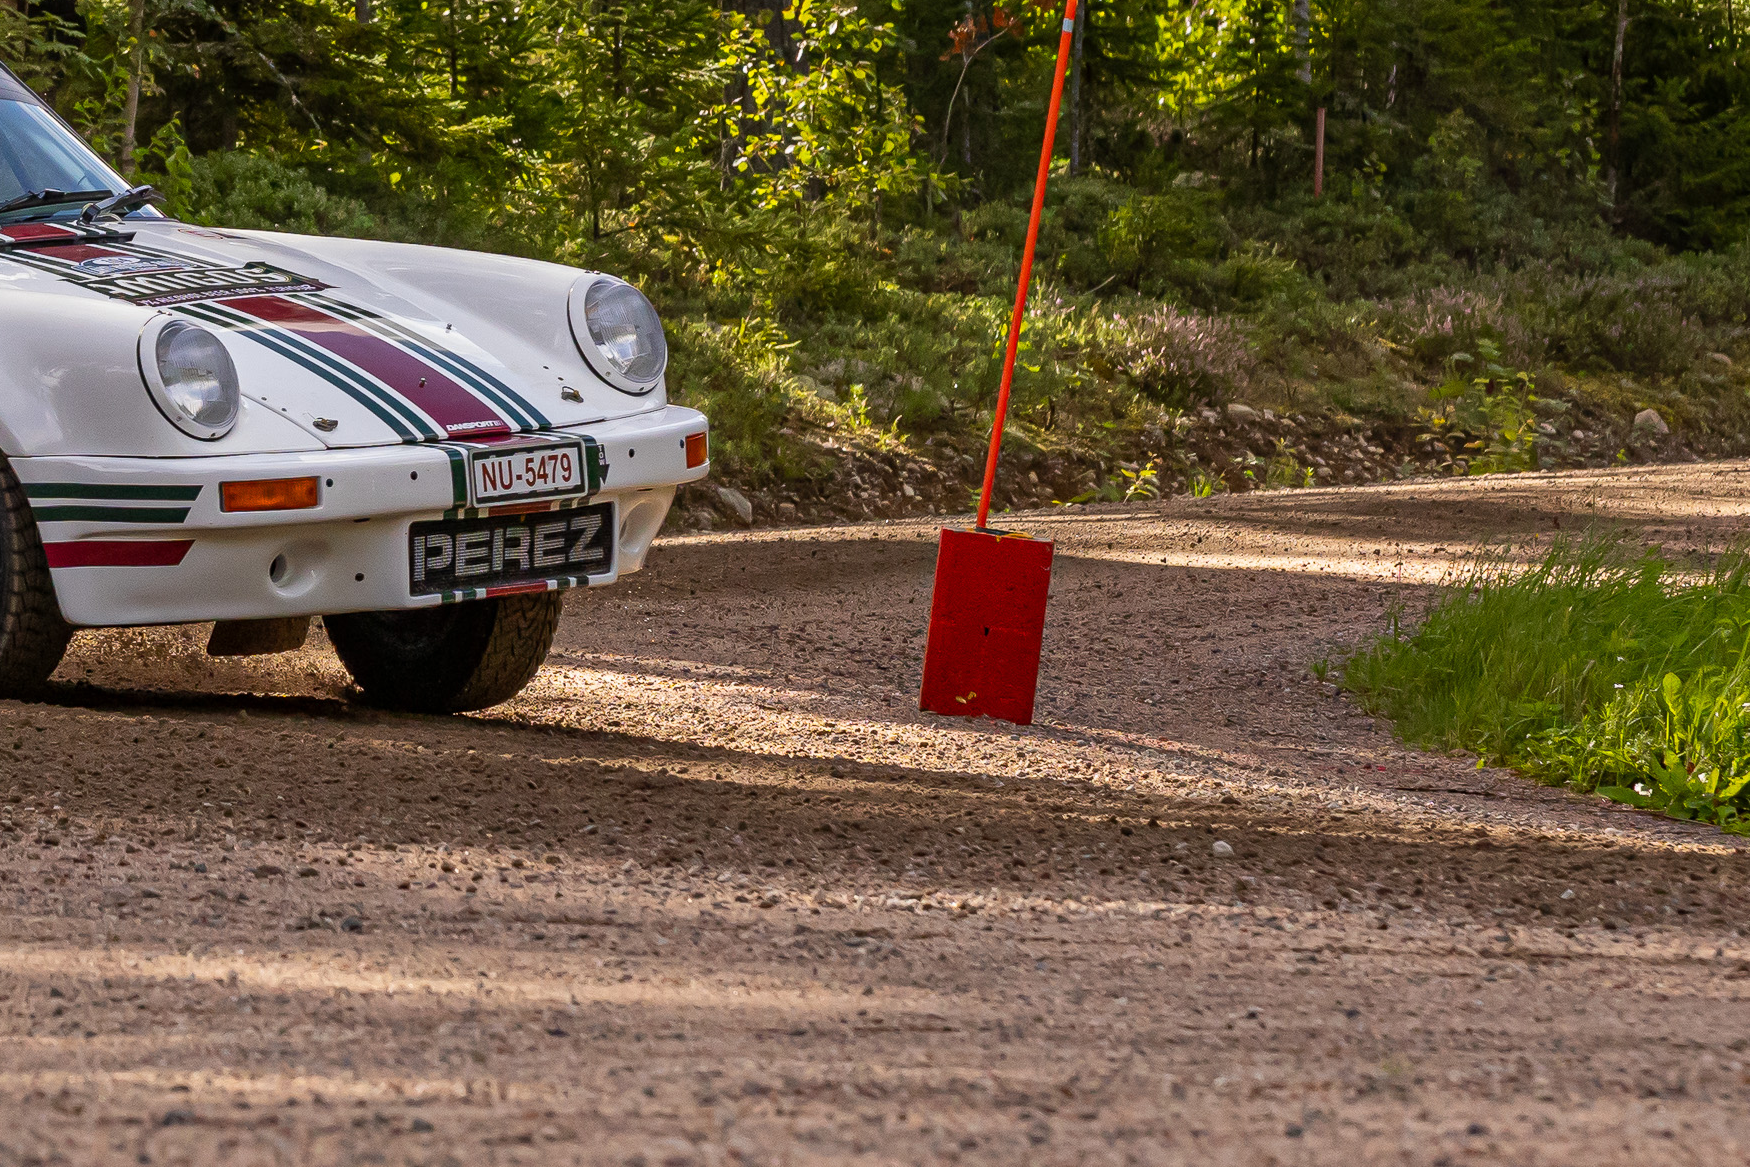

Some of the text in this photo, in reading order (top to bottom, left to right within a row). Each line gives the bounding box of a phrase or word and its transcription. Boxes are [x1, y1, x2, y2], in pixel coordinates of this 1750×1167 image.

[88, 268, 292, 296] AMIGOS
[481, 452, 573, 493] NU-5479
[413, 514, 604, 582] PEREZ
